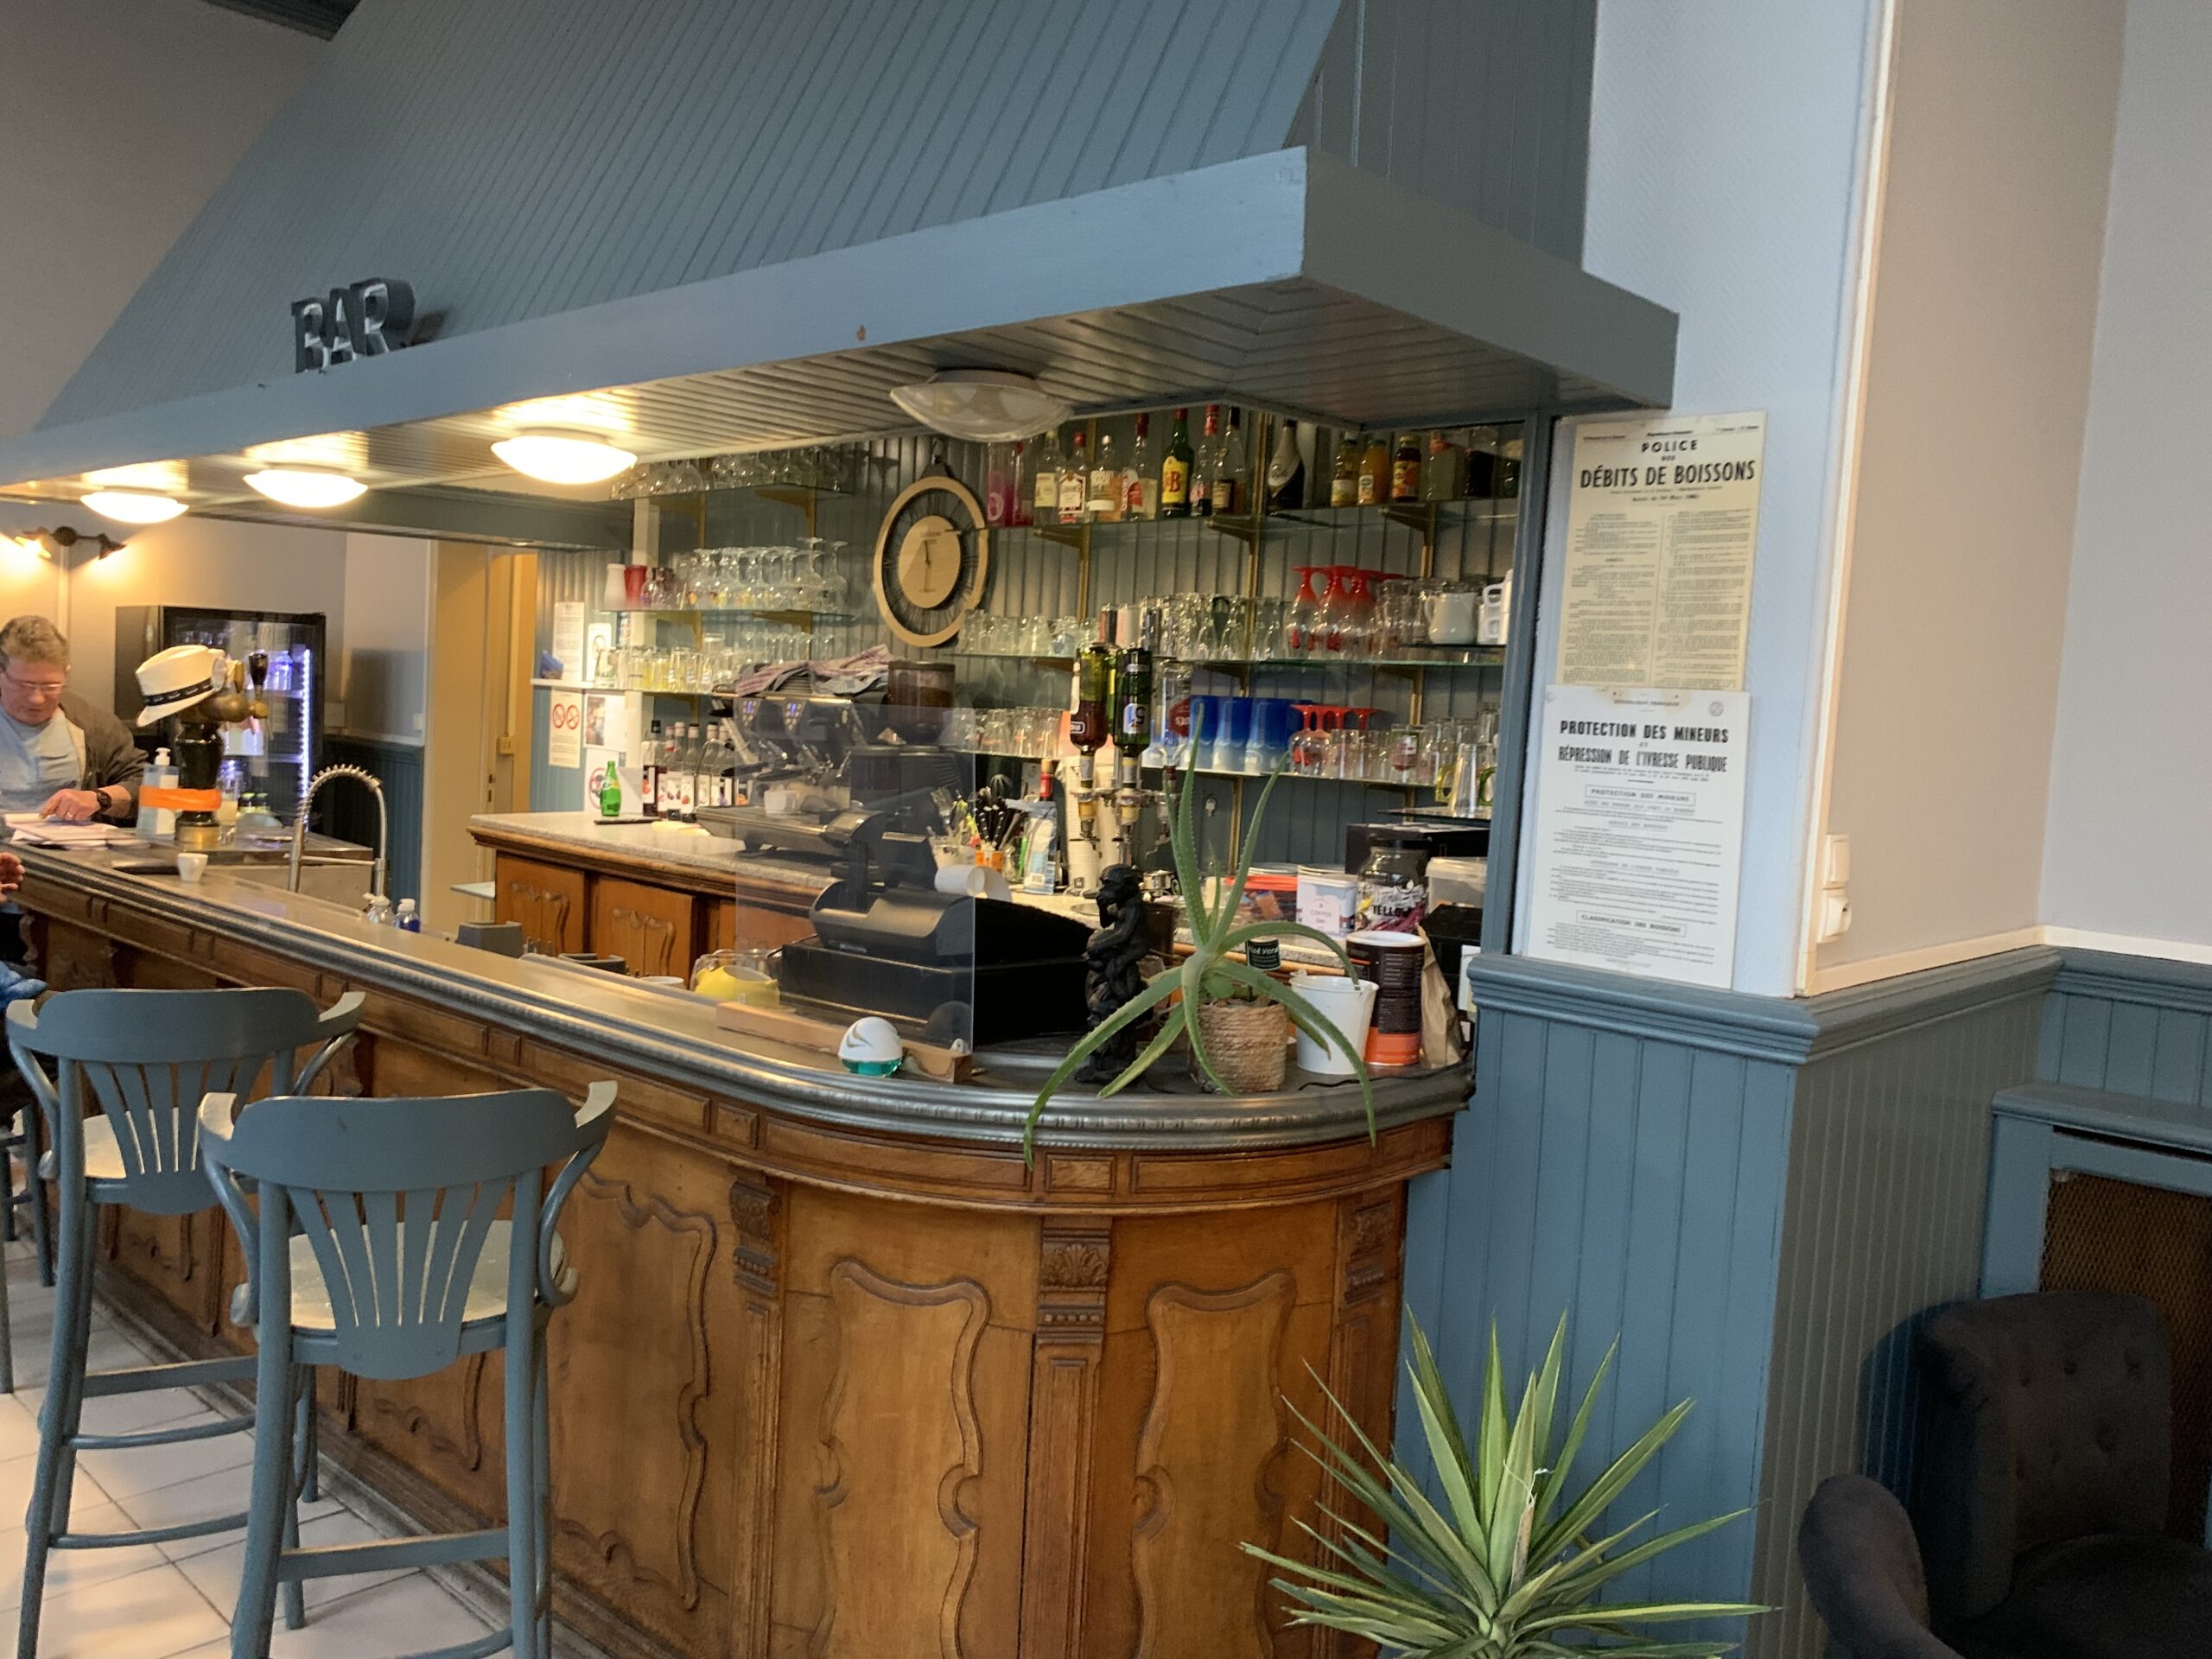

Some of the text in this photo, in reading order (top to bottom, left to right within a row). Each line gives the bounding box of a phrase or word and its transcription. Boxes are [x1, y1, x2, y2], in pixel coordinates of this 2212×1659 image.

[291, 277, 416, 373] BAR
[1642, 440, 1698, 454] POLICE
[1580, 460, 1756, 488] DÉBITS DE BOISSONS
[1560, 720, 1729, 743] PROTECTION DES MINEURS
[1618, 749, 1630, 765] DE
